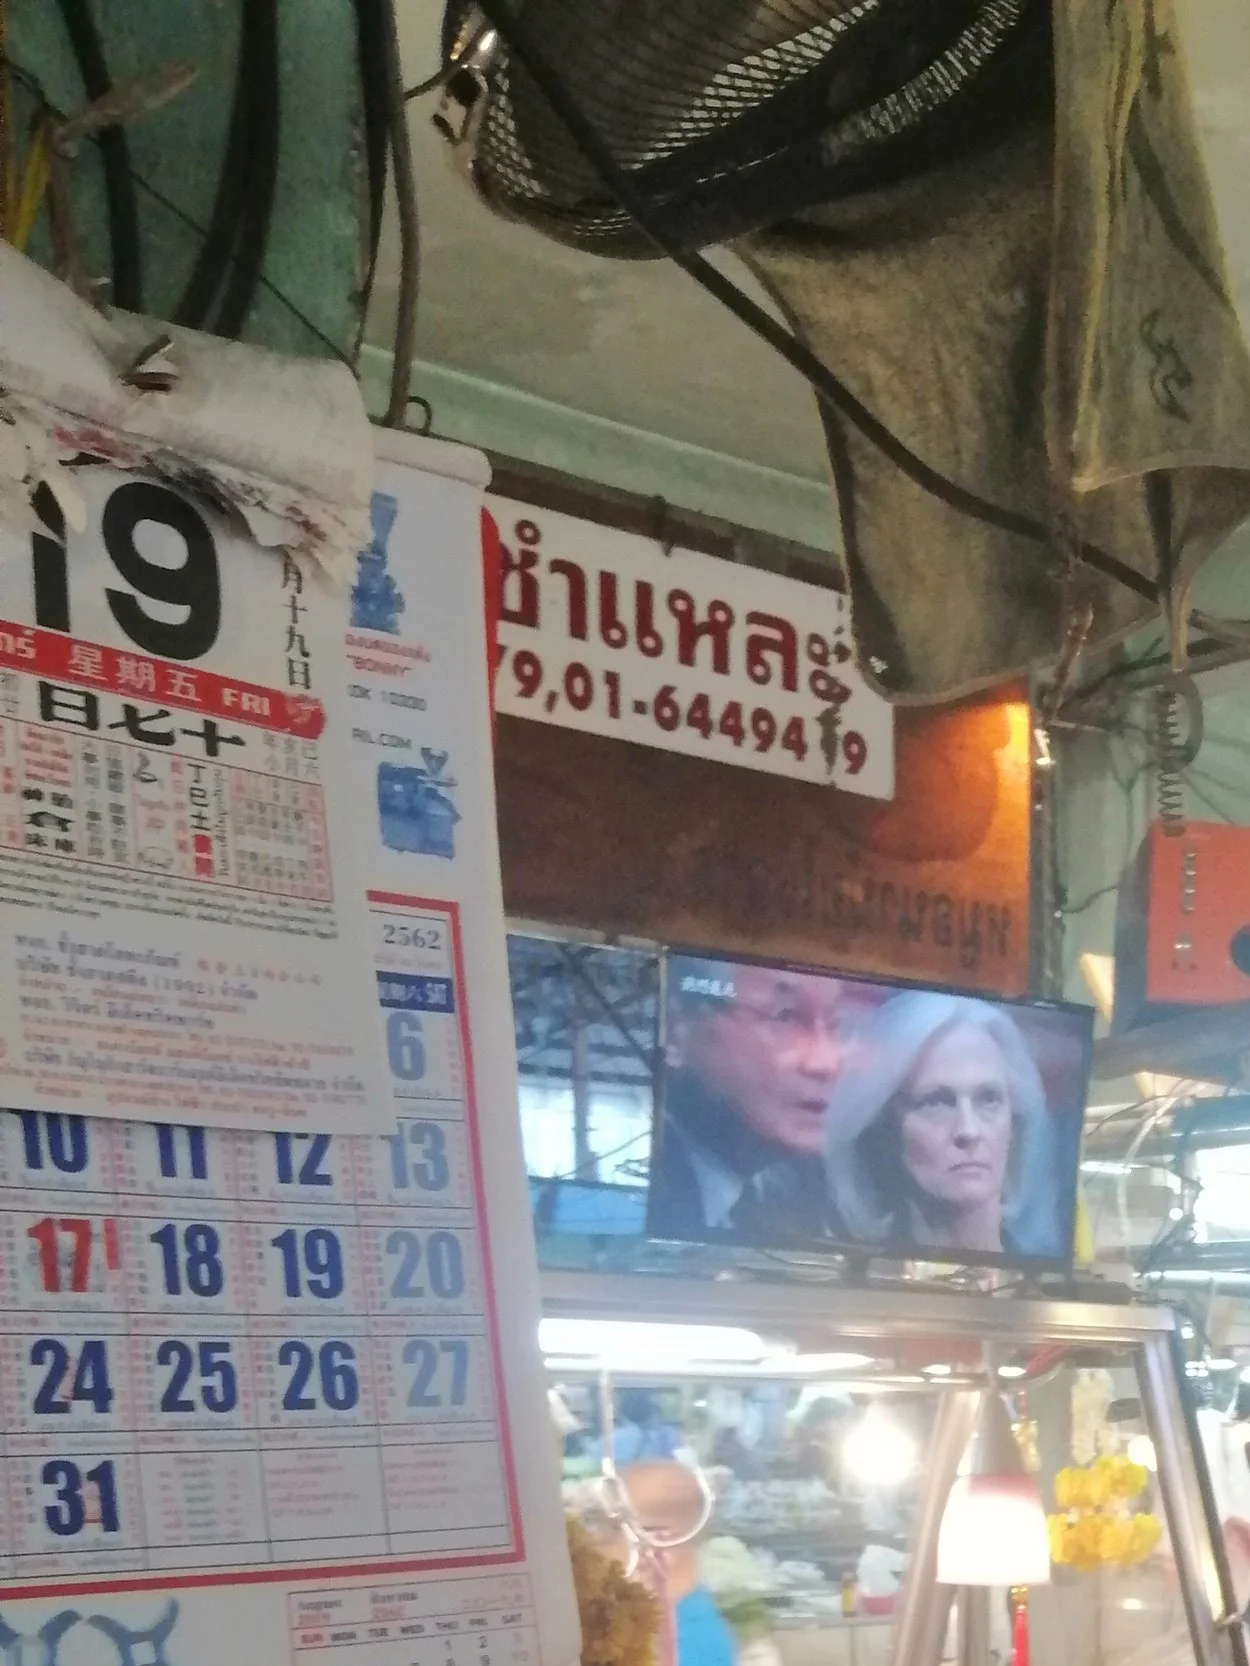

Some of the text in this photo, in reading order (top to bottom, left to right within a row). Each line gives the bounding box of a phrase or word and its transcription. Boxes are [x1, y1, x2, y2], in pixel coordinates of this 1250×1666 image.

[30, 480, 222, 661] 19
[68, 642, 203, 705] 星期五
[222, 687, 272, 716] FRI
[497, 643, 868, 776] 9,01-644949
[383, 924, 442, 951] 2562
[387, 1011, 425, 1081] 6
[21, 1112, 90, 1173] 10
[156, 1123, 208, 1179] 11
[386, 1121, 450, 1191] 13
[28, 1218, 464, 1300] 17 18 19 20
[30, 1338, 470, 1414] 24 25 26 27
[42, 1459, 121, 1536] 31
[479, 1636, 488, 1648] 2
